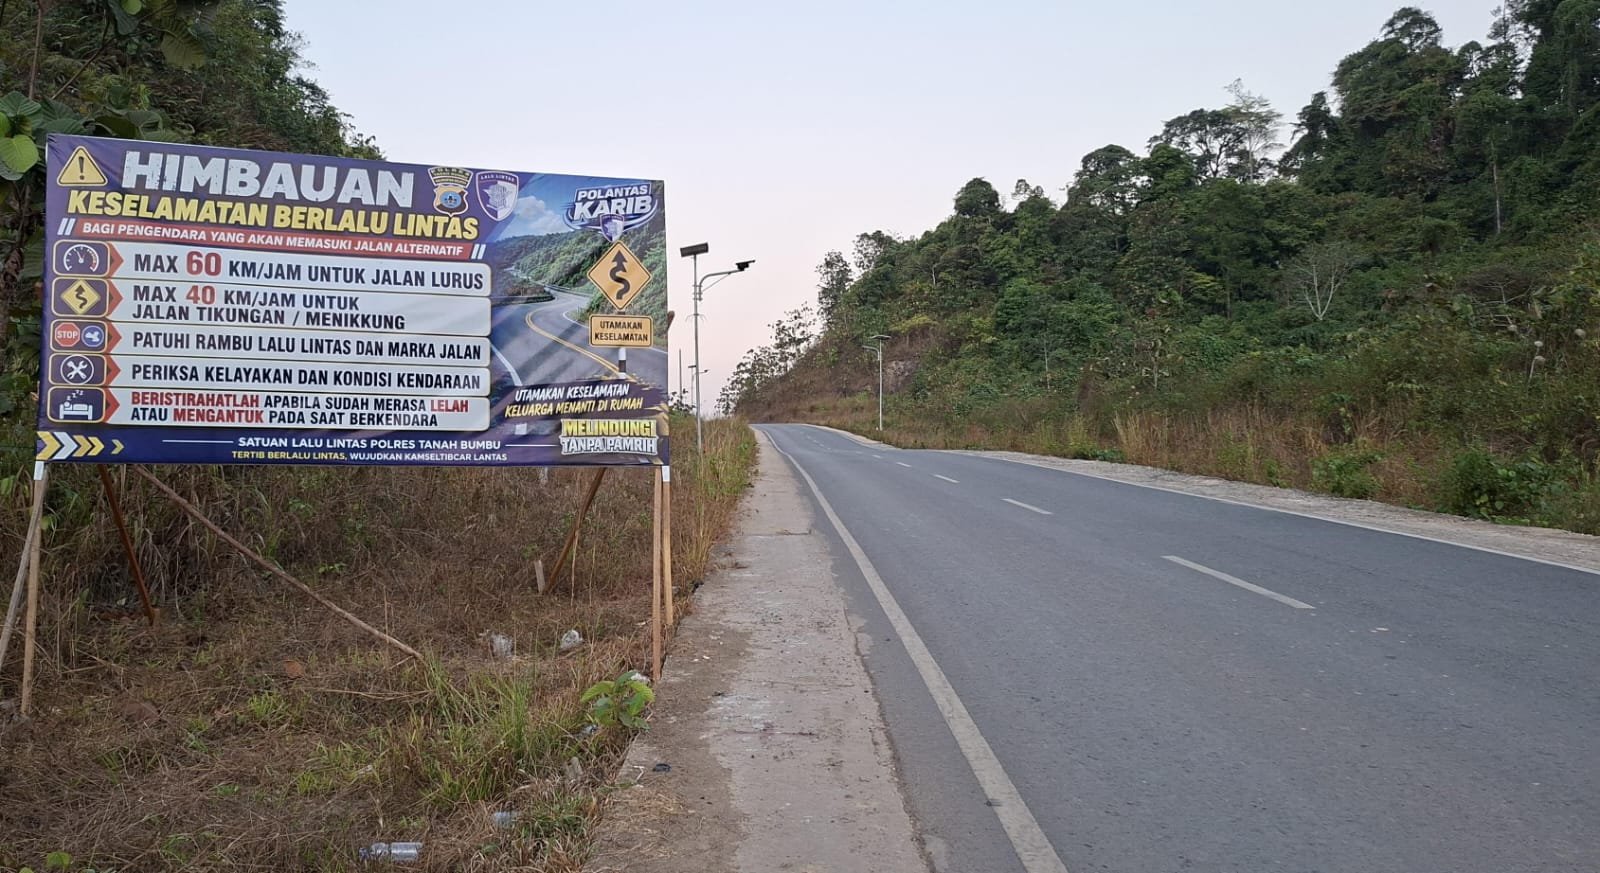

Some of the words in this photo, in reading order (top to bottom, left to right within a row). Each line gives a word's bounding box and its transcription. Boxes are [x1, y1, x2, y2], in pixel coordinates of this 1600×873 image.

[122, 150, 414, 208] HIMBAUAN
[577, 185, 649, 200] POLANTAS
[67, 190, 268, 226] KESELAMATAN
[273, 205, 388, 234] BERLALU
[393, 213, 479, 240] LINTAS
[573, 196, 653, 221] KARIB
[83, 222, 114, 234] BAGI
[118, 224, 207, 241] PENGENDARA
[211, 231, 245, 243] YANG
[248, 234, 283, 246] AKAN
[286, 236, 351, 250] MEMASUKI
[354, 242, 394, 252] JALAN
[397, 243, 463, 256] ALTERNATIF
[134, 253, 178, 273] MAX
[186, 251, 222, 276] 60
[229, 260, 300, 280] KM/JAM
[308, 265, 365, 284] UNTUK
[372, 269, 425, 287] JALAN
[432, 271, 483, 289] LURUS
[133, 285, 177, 302] MAX
[186, 285, 216, 305] 40
[224, 290, 295, 308] KM/JAM
[303, 294, 359, 310] UNTUK
[133, 304, 189, 320] JALAN
[197, 307, 285, 325] TIKUNGAN
[292, 311, 300, 326] /
[306, 311, 405, 330] MENIKKUNG
[599, 321, 642, 330] UTAMAKAN
[57, 330, 78, 339] STOP
[594, 332, 648, 342] KESELAMATAN
[133, 332, 190, 349] PATUHI
[196, 334, 252, 351] RAMBU
[258, 336, 295, 353] LALU
[301, 338, 351, 355] LINTAS
[356, 340, 384, 356] DAN
[388, 342, 436, 358] MARKA
[440, 344, 481, 360] JALAN
[132, 364, 199, 382] PERIKSA
[205, 366, 292, 384] KELAYAKAN
[299, 369, 328, 385] DAN
[333, 371, 392, 387] KONDISI
[397, 372, 480, 390] KENDARAAN
[131, 391, 260, 408] BERISTIRAHATLAH
[264, 394, 320, 410] APABILA
[325, 396, 369, 411] SUDAH
[374, 397, 426, 412] MERASA
[430, 400, 469, 413] LELAH
[515, 387, 564, 402] UTAMAKAN
[566, 384, 630, 399] KESELAMATAN
[131, 408, 168, 422] ATAU
[173, 409, 264, 424] MENGANTUK
[269, 410, 305, 425] PADA
[310, 411, 345, 425] SAAT
[350, 412, 438, 427] BERKENDARA
[505, 403, 553, 418] KELUARGA
[556, 400, 596, 415] MENANTI
[597, 401, 608, 411] DI
[610, 397, 643, 411] RUMAH
[562, 420, 656, 437] MELINDUNGI
[238, 437, 288, 448] SATUAN
[292, 438, 323, 448] LALU
[326, 438, 367, 449] LINTAS
[371, 439, 416, 449] POLRES
[418, 440, 457, 450] TANAH
[461, 440, 501, 450] BUMBU
[562, 437, 606, 453] TANPA
[606, 437, 657, 454] PAMRIH
[232, 451, 265, 459] TERTIB
[267, 451, 310, 460] BERLALU
[313, 451, 347, 461] LINTAS,
[350, 452, 402, 461] WUJUDKAN
[404, 452, 471, 461] KAMSELTIBCAR
[473, 453, 507, 461] LANTAS
